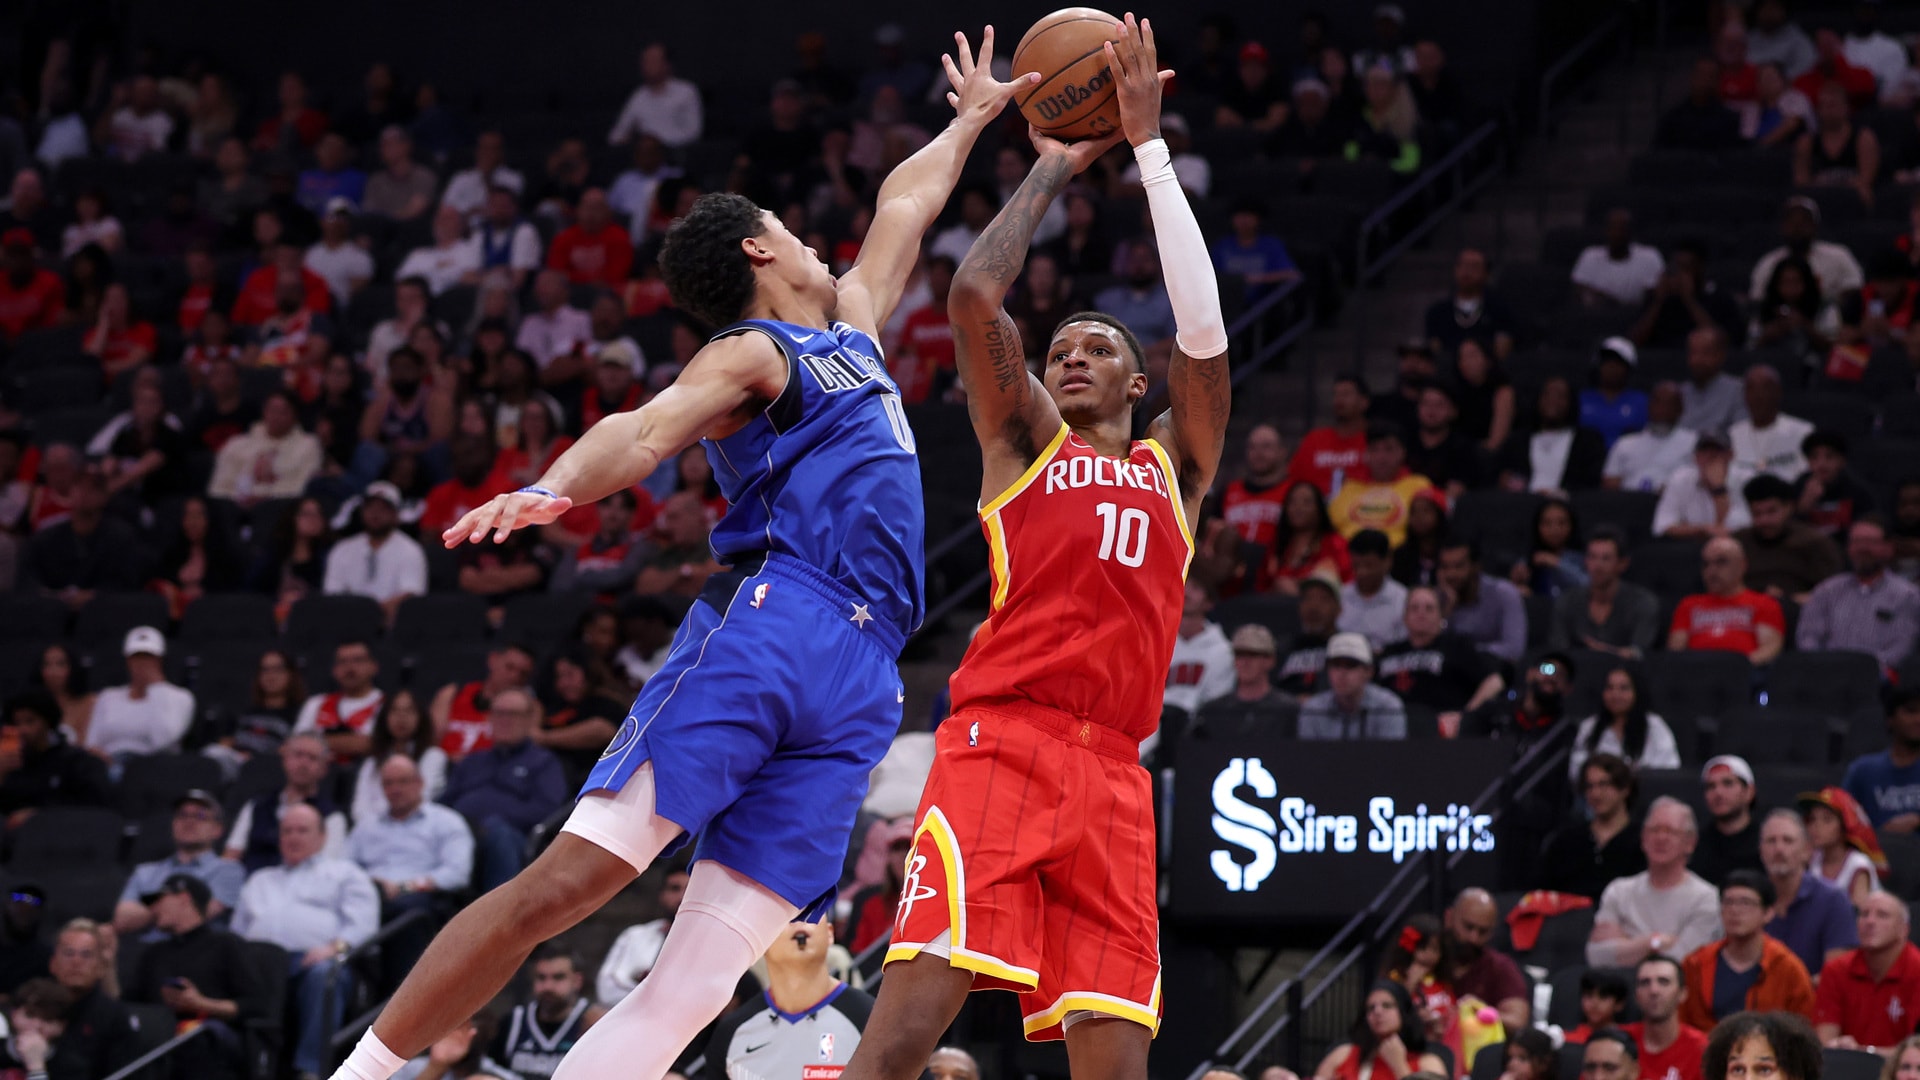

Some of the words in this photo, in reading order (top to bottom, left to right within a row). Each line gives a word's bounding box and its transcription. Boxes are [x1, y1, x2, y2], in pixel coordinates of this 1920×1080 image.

[1034, 65, 1112, 121] Wilson
[983, 317, 1014, 393] POTENTIAL
[880, 392, 916, 455] 0
[1095, 501, 1151, 568] 10
[1279, 797, 1358, 853] Sire
[1367, 796, 1496, 864] Spirits
[803, 1067, 842, 1079] Emirate
